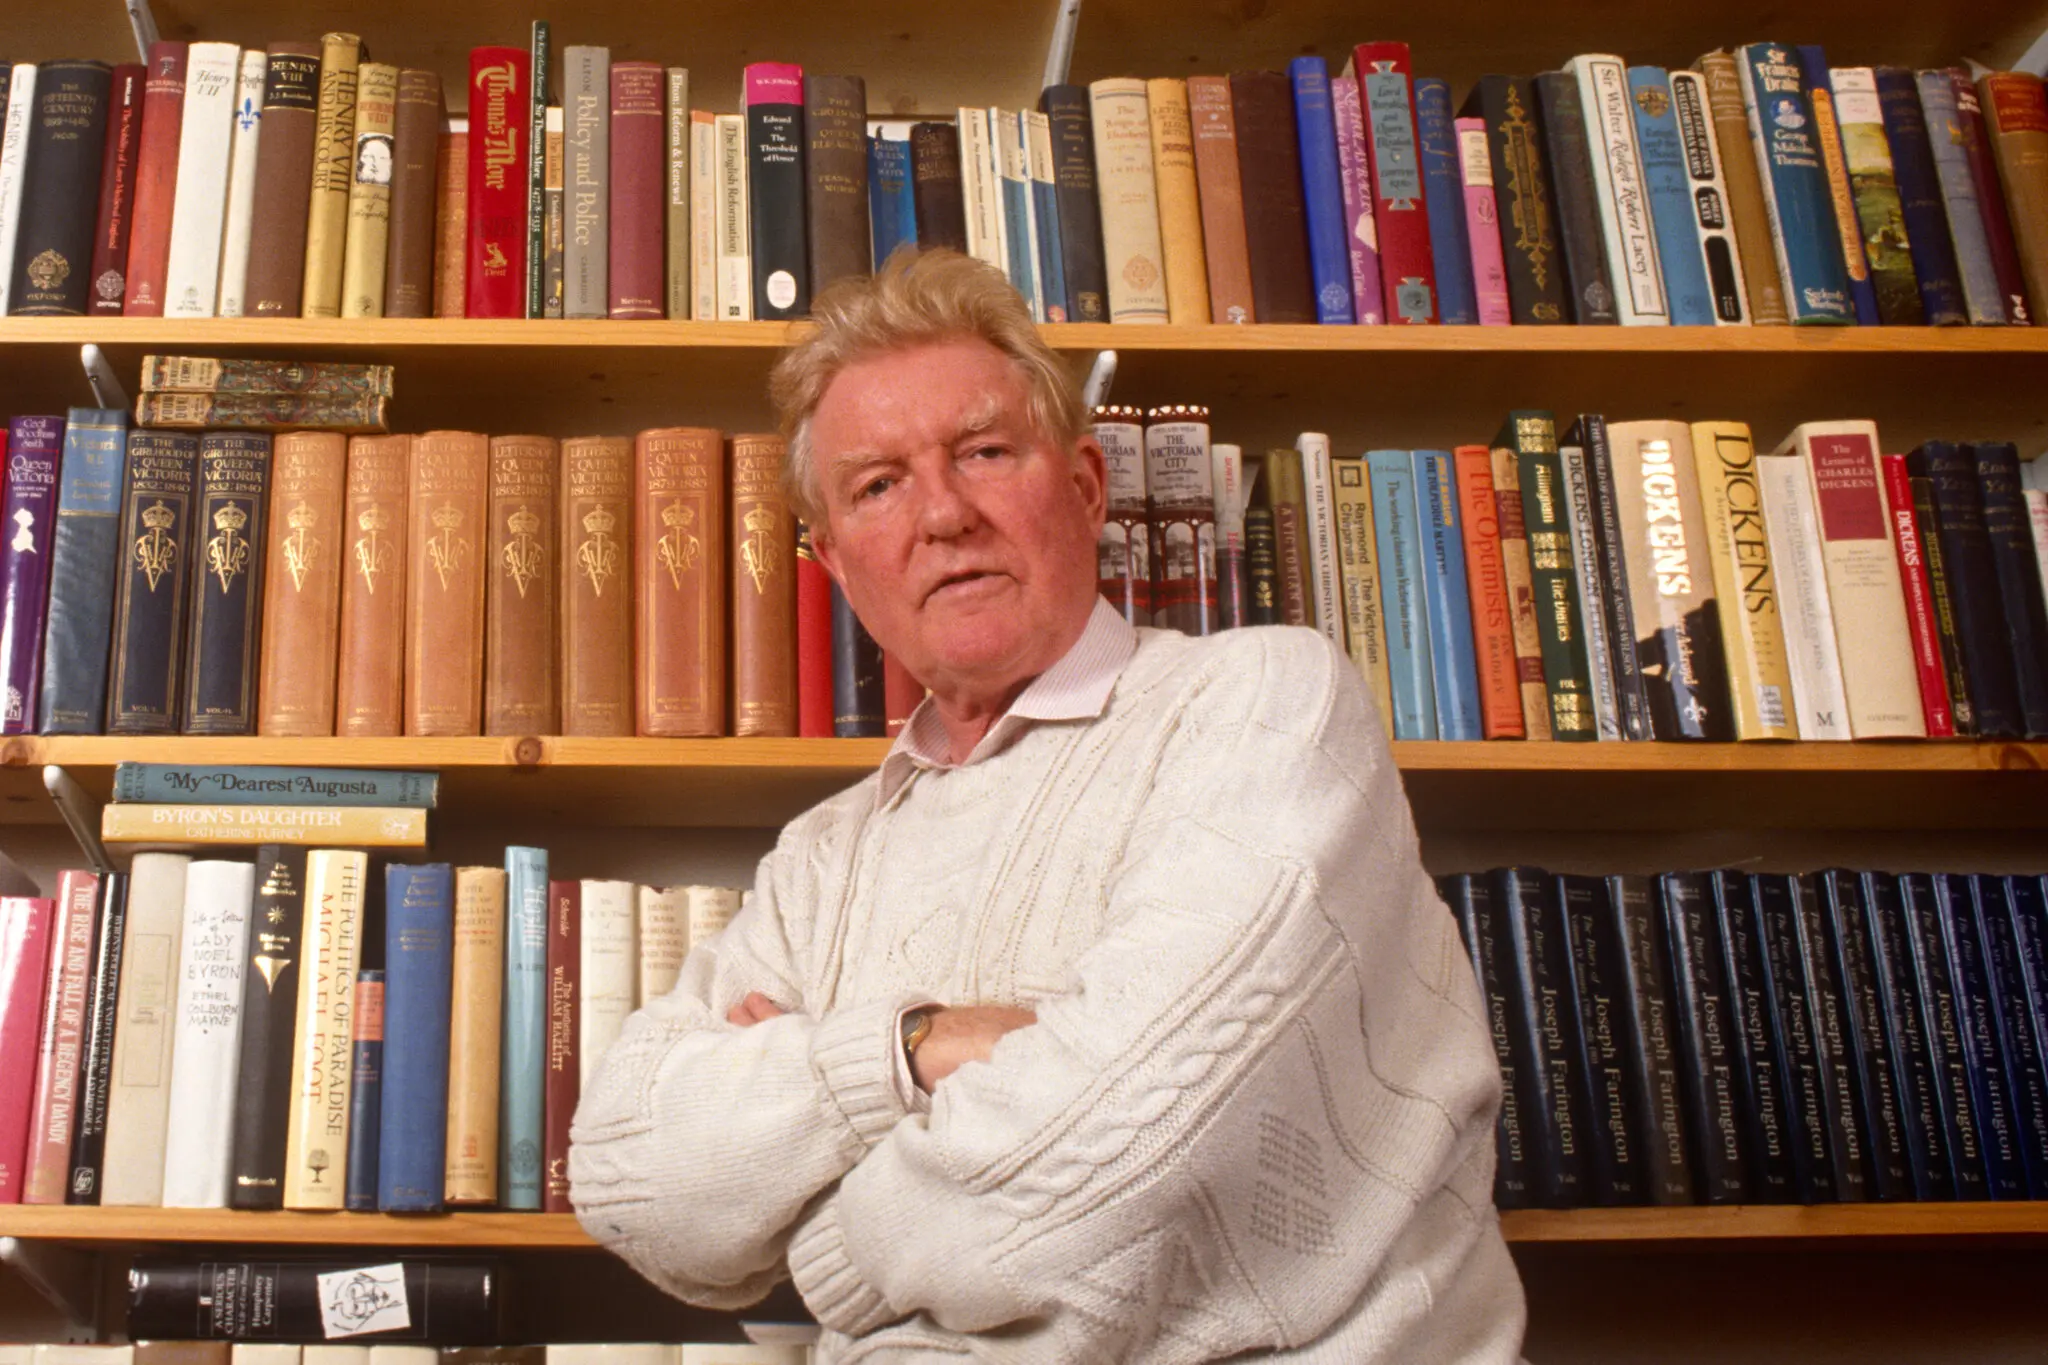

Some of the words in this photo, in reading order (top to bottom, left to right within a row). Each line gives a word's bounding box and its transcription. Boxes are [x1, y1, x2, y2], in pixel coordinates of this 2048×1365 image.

[271, 61, 316, 73] HENRY
[583, 58, 593, 93] ELTON
[1766, 48, 1787, 65] Sir
[197, 69, 232, 87] Henry
[281, 72, 303, 82] VIII
[321, 70, 337, 110] AND
[671, 75, 684, 105] Elton:
[1376, 86, 1401, 98] Lord
[1599, 65, 1618, 89] Sir
[1762, 76, 1800, 93] Drake
[44, 104, 94, 115] CENTURY
[334, 69, 357, 146] HENRY
[476, 61, 517, 135] Thomas
[533, 104, 544, 118] Sir
[1602, 90, 1627, 135] Walter
[4, 104, 22, 149] HENRY
[533, 119, 545, 153] Thomas
[569, 95, 599, 149] Policy
[671, 107, 683, 146] Reform
[725, 126, 738, 145] The
[762, 115, 793, 124] Edward
[770, 134, 787, 142] The
[314, 136, 332, 189] COURT
[484, 127, 517, 190] More
[531, 156, 543, 179] More
[725, 148, 739, 184] English
[759, 144, 799, 153] Threshold
[575, 153, 598, 185] and
[671, 160, 684, 205] Renewal
[575, 192, 598, 245] Police
[726, 188, 739, 252] Reformation
[1615, 185, 1646, 234] Robert
[1624, 232, 1653, 279] Lacey
[22, 418, 46, 429] Cecil
[70, 436, 120, 451] Victoria
[153, 439, 174, 448] THE
[1164, 434, 1186, 445] THE
[1590, 421, 1601, 441] THE
[11, 455, 52, 472] Queen
[132, 447, 183, 458] GIRLHOOD
[203, 448, 252, 459] GIRLHOOD
[223, 439, 245, 449] THE
[1150, 445, 1204, 458] VICTORIAN
[1164, 456, 1188, 468] CITY
[1593, 443, 1607, 483] WORLD
[1821, 456, 1855, 467] Letters
[1856, 456, 1865, 465] of
[1831, 444, 1850, 454] The
[8, 469, 56, 484] Victoria
[132, 468, 192, 483] VICTORIA
[204, 469, 263, 483] VICTORIA
[648, 466, 708, 478] VICTORIA
[1387, 479, 1401, 498] The
[1468, 469, 1497, 513] The
[1816, 466, 1873, 478] CHARLES
[1819, 479, 1874, 490] DICKENS
[1315, 484, 1324, 504] THE
[1531, 462, 1557, 525] Allingham
[1316, 506, 1329, 560] VICTORIAN
[1337, 502, 1357, 566] Chapman
[1351, 502, 1372, 565] Raymond
[1387, 499, 1405, 535] working
[1425, 456, 1437, 473] THE
[1431, 529, 1449, 576] MARTYRS
[1600, 498, 1615, 542] CHARLES
[1713, 426, 1775, 615] DICKENS
[1713, 495, 1730, 558] biography
[1392, 535, 1408, 568] classes
[1895, 508, 1920, 567] DICKENS
[1280, 521, 1302, 600] VICTORIAN
[1469, 514, 1509, 628] Optimists
[1577, 527, 1600, 599] LONDON
[1606, 543, 1622, 590] DICKENS
[1640, 438, 1691, 597] DICKENS
[1676, 635, 1699, 686] Ackroyd
[1320, 564, 1333, 619] CHRISTIAN
[1346, 576, 1363, 624] Debate
[1359, 575, 1375, 601] The
[1396, 577, 1413, 619] Victorian
[1549, 577, 1568, 599] The
[1911, 581, 1924, 612] POPULAR
[1552, 599, 1574, 642] Diaries
[1613, 593, 1628, 631] ANGUS
[1362, 603, 1381, 664] Victorian
[1916, 611, 1934, 666] ENTERTAINMENT
[1487, 634, 1503, 693] BRADLEY
[1619, 633, 1634, 675] WILSON
[1816, 711, 1835, 727] M
[122, 762, 134, 799] PETER
[164, 771, 210, 791] My
[212, 773, 294, 793] Dearest
[295, 775, 378, 798] Augusta
[152, 807, 234, 827] BYRON'S
[240, 808, 342, 827] DAUGHTER
[258, 827, 306, 841] TURNEY
[72, 885, 94, 911] THE
[339, 863, 360, 903] THE
[68, 912, 91, 943] RISE
[109, 914, 124, 954] BYRON'S
[514, 884, 548, 949] Hazlitt
[559, 897, 572, 937] Schneider
[65, 945, 88, 971] AND
[192, 934, 234, 947] LADY
[193, 949, 235, 962] NOEL
[316, 893, 336, 1015] MICHAEL
[332, 907, 359, 996] POLITICS
[61, 973, 85, 1007] FALL
[104, 953, 119, 1001] POLITICAL
[188, 964, 242, 980] BYRON
[552, 966, 564, 1017] WILLIAM
[562, 982, 572, 999] The
[58, 1028, 78, 1037] A
[60, 1007, 80, 1025] OF
[102, 1004, 114, 1026] AND
[187, 1016, 231, 1027] MAYNE
[332, 1000, 351, 1030] OF
[1541, 986, 1565, 1050] Joseph
[1594, 995, 1616, 1058] Joseph
[1702, 991, 1725, 1057] Joseph
[1746, 987, 1767, 1053] Joseph
[1864, 985, 1882, 1050] Joseph
[1902, 989, 1920, 1053] Joseph
[2012, 994, 2032, 1059] Joseph
[96, 1025, 112, 1075] CULTURAL
[551, 1020, 563, 1071] HAZLITT
[51, 1042, 77, 1102] REGENCY
[303, 1032, 326, 1104] FOOT
[322, 1033, 352, 1137] PARADISE
[1491, 994, 1511, 1057] Joseph
[1501, 1066, 1524, 1161] Farington
[1648, 995, 1670, 1060] Joseph
[1659, 1069, 1682, 1164] Farington
[1789, 991, 1809, 1055] Joseph
[1799, 1063, 1824, 1160] Farington
[1824, 990, 1843, 1056] Joseph
[1835, 1063, 1860, 1160] Farington
[1937, 989, 1960, 1055] Joseph
[1950, 1063, 1976, 1159] Farington
[1973, 993, 1993, 1059] Joseph
[1986, 1067, 2012, 1162] Farington
[46, 1103, 70, 1145] DANDY
[91, 1078, 108, 1133] INFLUENCE
[1551, 1059, 1575, 1155] Farington
[1604, 1067, 1629, 1163] Farington
[1713, 1065, 1738, 1161] Farington
[1756, 1061, 1781, 1156] Farington
[215, 1272, 225, 1319] SERIOUS
[224, 1267, 237, 1335] CHARACTER
[252, 1275, 263, 1329] Humphrey
[262, 1276, 275, 1326] Carpenter
